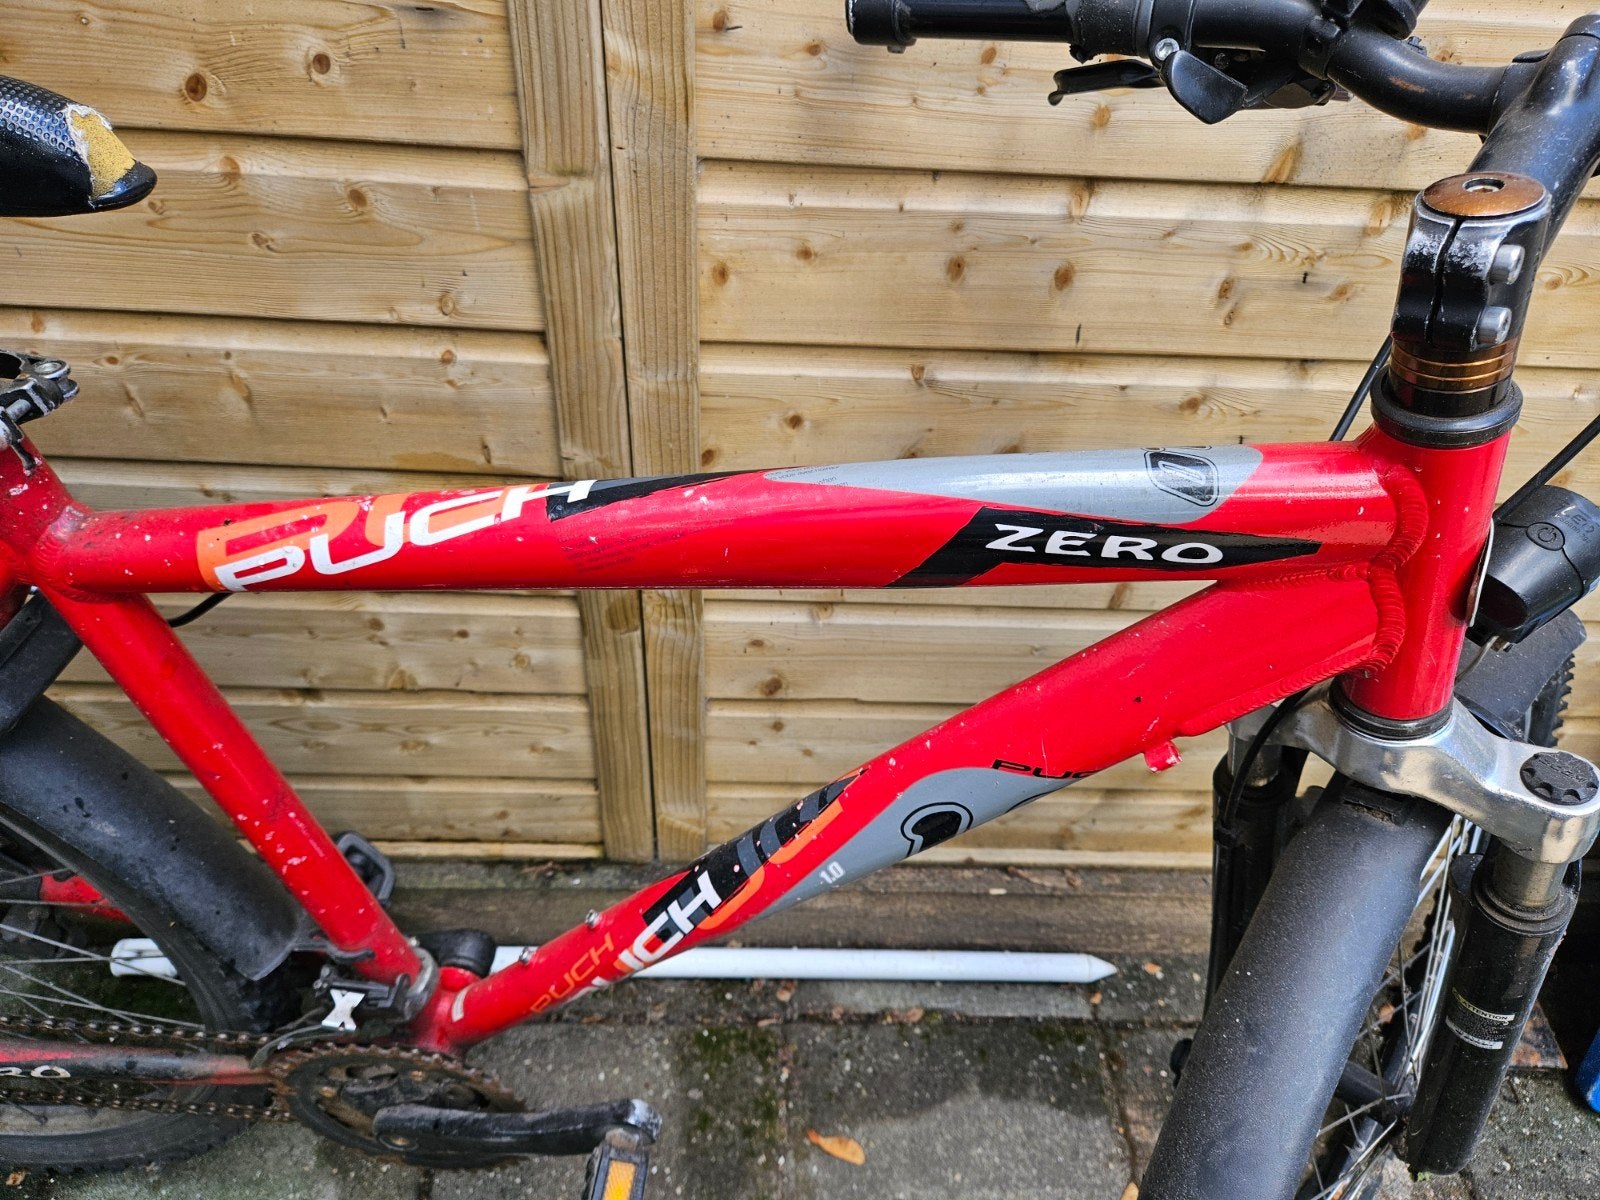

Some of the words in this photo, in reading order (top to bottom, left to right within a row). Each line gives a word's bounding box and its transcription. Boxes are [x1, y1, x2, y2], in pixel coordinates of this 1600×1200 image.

[214, 479, 597, 592] PUCH
[985, 523, 1224, 564] ZERO
[819, 861, 845, 884] 1.0
[530, 931, 615, 1013] PUCH
